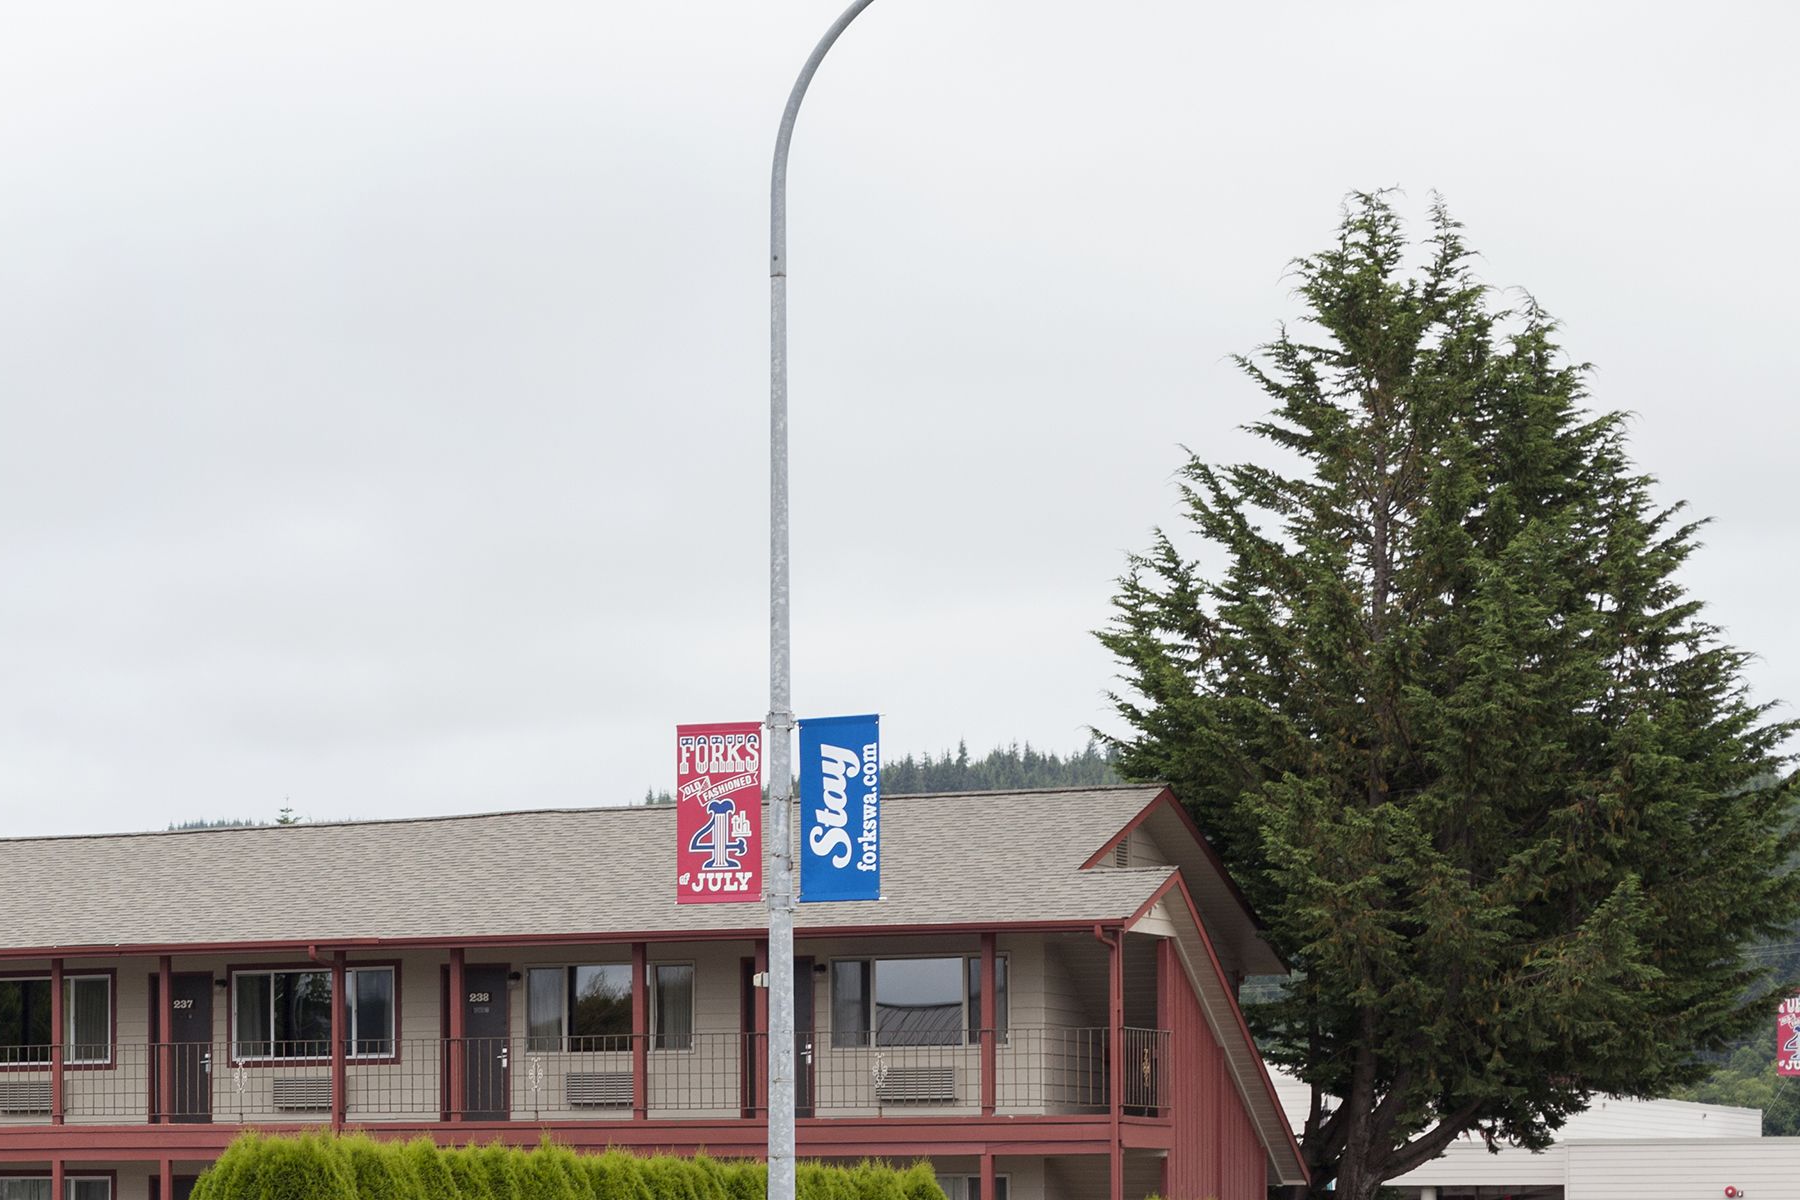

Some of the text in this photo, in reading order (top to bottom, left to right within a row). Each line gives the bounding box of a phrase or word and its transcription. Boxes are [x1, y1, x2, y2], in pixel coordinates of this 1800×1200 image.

[679, 733, 759, 775] FORKS
[685, 775, 752, 801] OLD FASHIONED
[809, 744, 860, 869] Stay
[857, 742, 877, 872] forkswa.com
[689, 798, 752, 870] 4th
[679, 872, 752, 892] of JULY
[173, 1000, 193, 1009] 237
[469, 993, 489, 1002] 238
